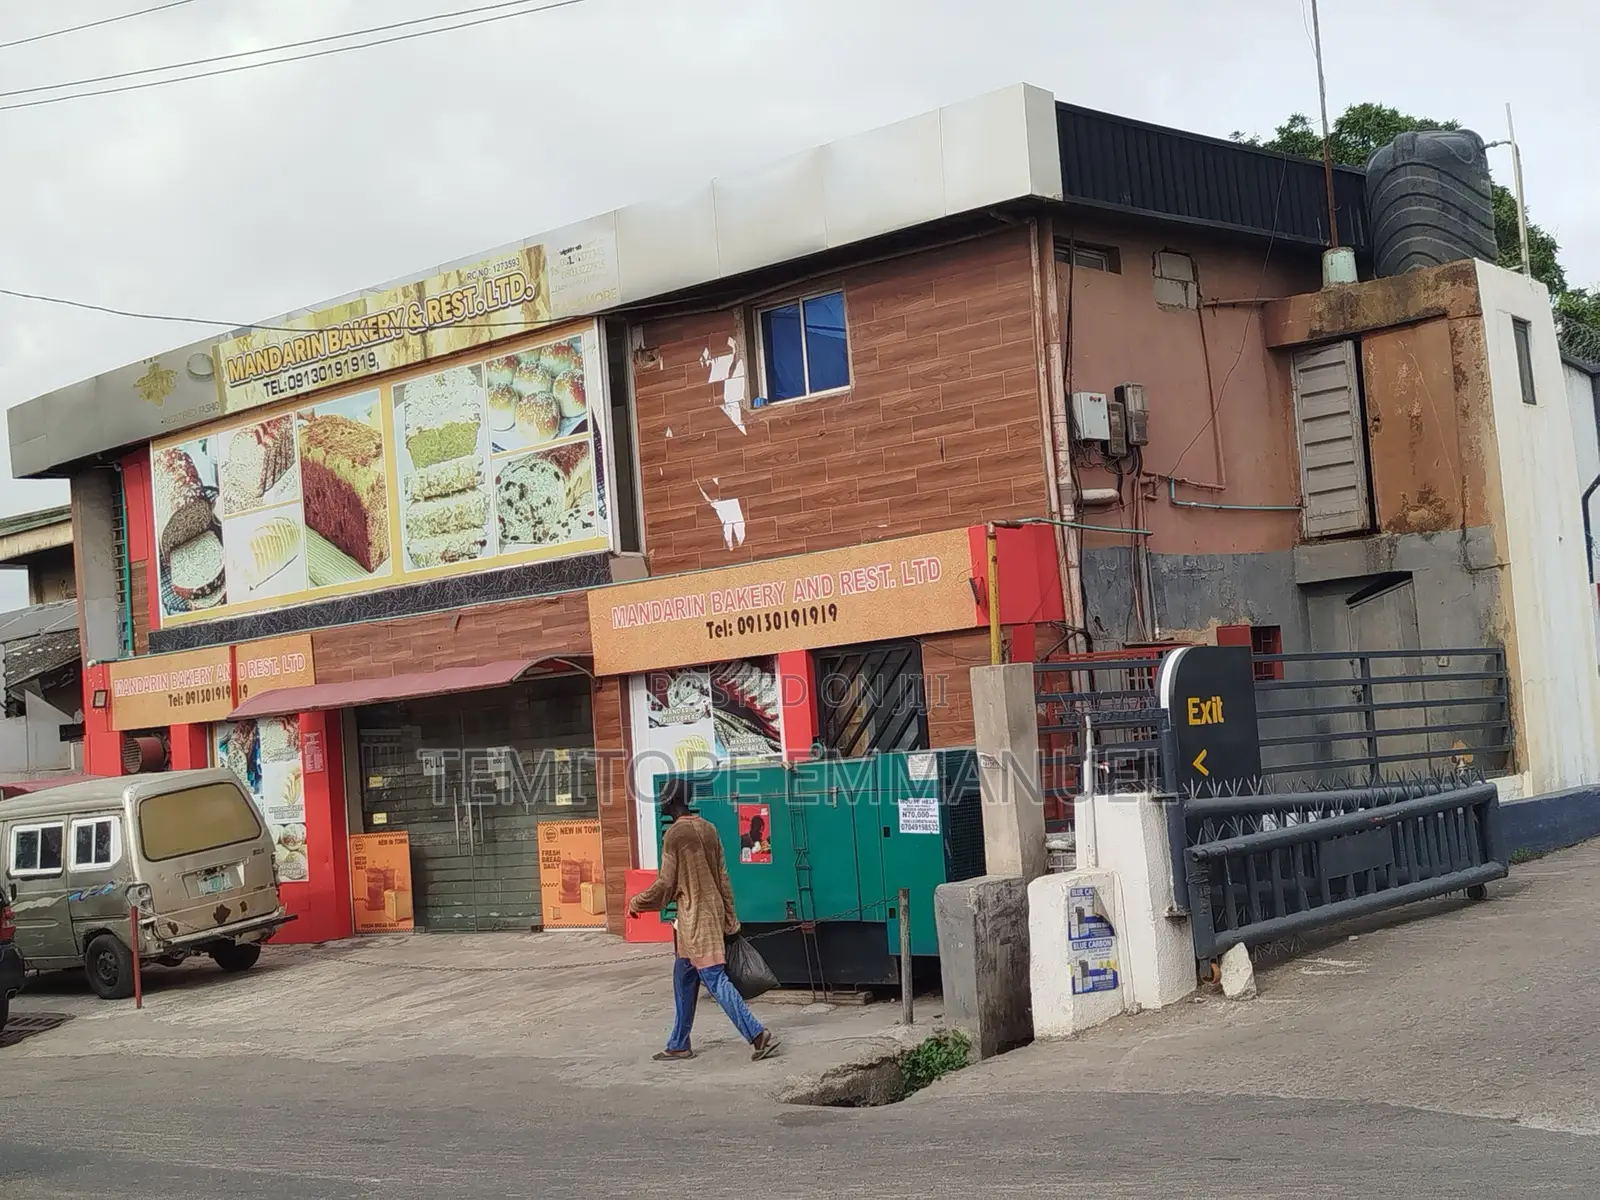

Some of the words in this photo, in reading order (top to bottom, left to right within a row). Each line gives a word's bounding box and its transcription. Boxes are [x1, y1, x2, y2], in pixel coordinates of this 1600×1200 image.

[226, 331, 325, 388] MANDARIN
[325, 304, 404, 358] BAKERY
[406, 301, 428, 334] &
[484, 270, 536, 314] LTD.
[612, 594, 706, 630] MANDARIN
[709, 580, 787, 615] BAKERY
[793, 573, 834, 604] AND
[839, 563, 897, 597] REST.
[900, 556, 942, 587] LTD
[705, 618, 733, 640] Tel:
[736, 602, 838, 636] 09130191919
[114, 673, 169, 698] MANDARIN
[170, 665, 214, 690] BAKERY
[248, 655, 281, 679] REST.
[281, 652, 306, 674] LTD
[168, 692, 184, 708] Tel:
[1187, 695, 1225, 726] Exit
[423, 755, 444, 770] PULL
[560, 825, 574, 835] NEW
[575, 825, 582, 835] IN
[1071, 888, 1083, 896] BLUE
[1073, 941, 1087, 950] BLUE
[1088, 938, 1112, 948] CARBON
